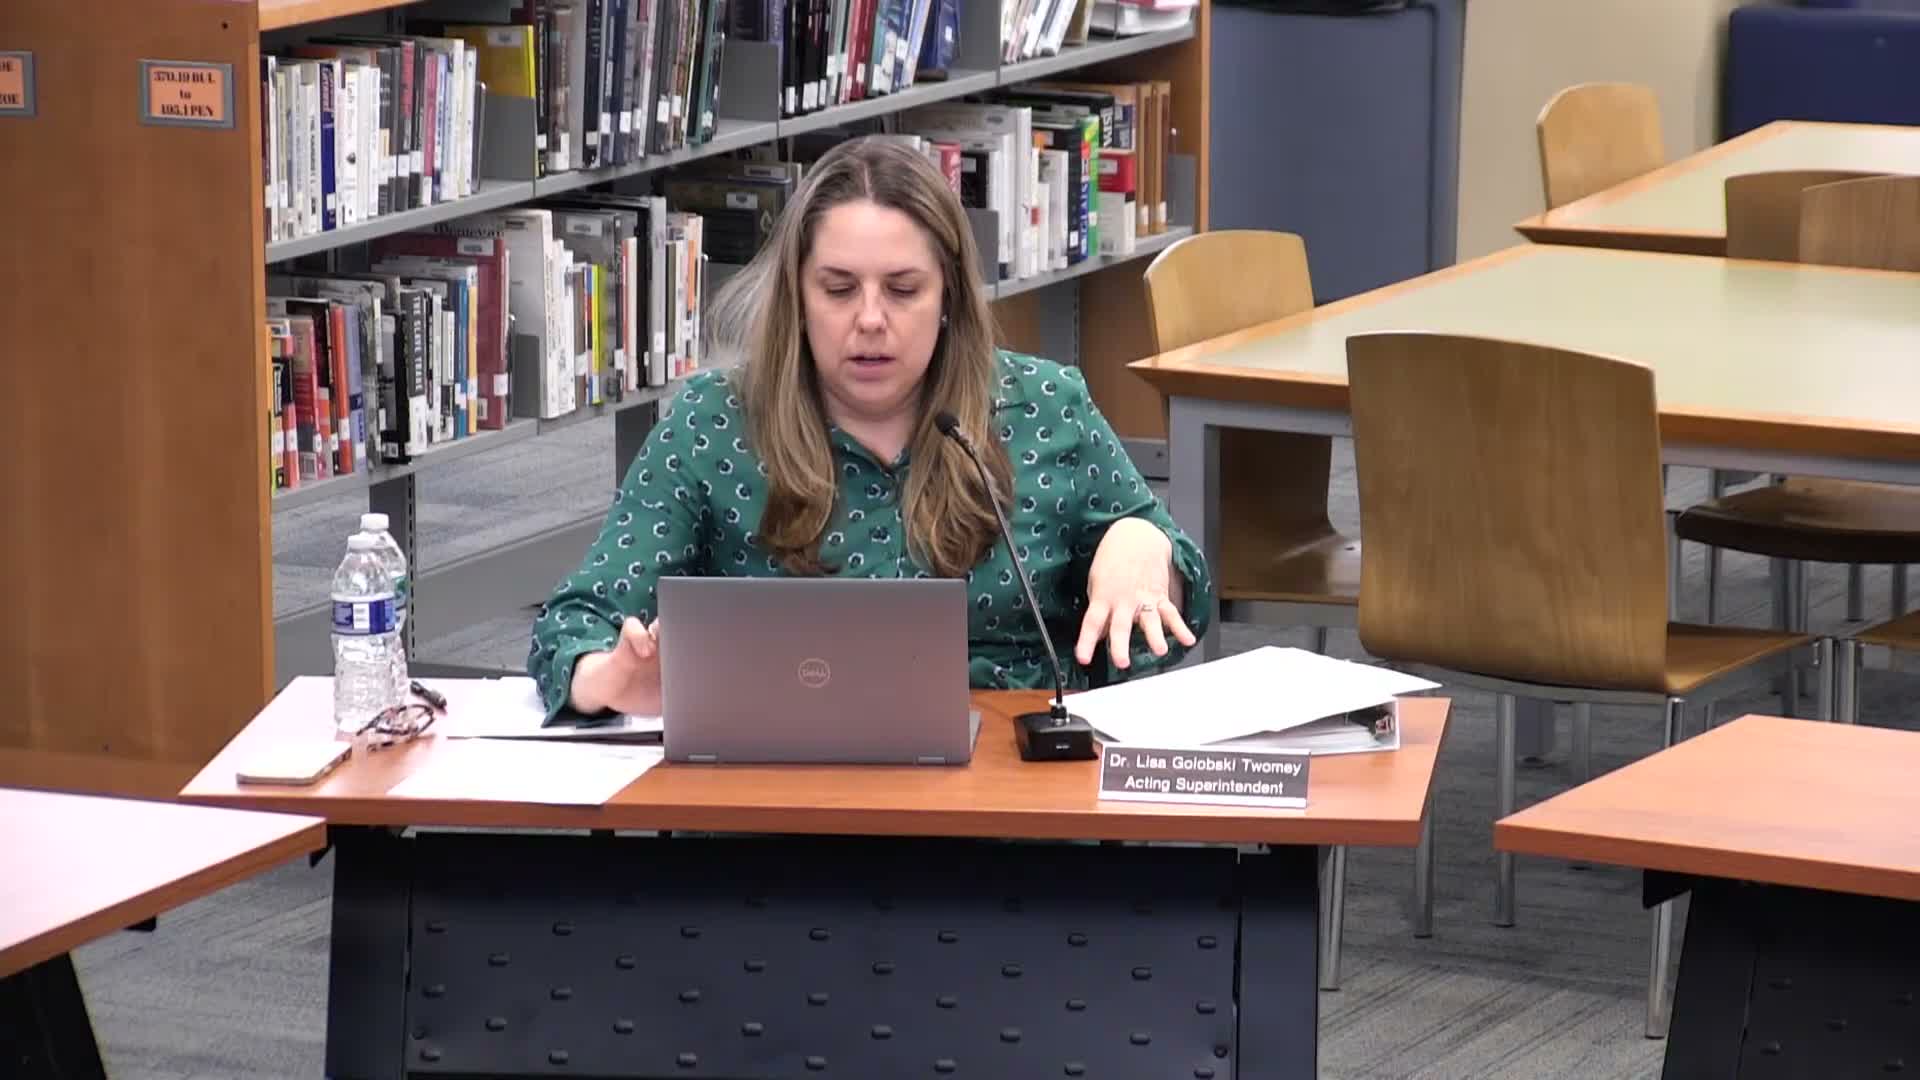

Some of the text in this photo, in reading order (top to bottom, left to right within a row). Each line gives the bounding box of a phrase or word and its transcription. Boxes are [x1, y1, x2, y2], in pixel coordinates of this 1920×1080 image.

[179, 89, 192, 99] to
[190, 104, 214, 117] PEN
[1109, 753, 1302, 777] Dr. Lisa Golobski Twomey
[1124, 775, 1284, 795] Acting Superintendent
